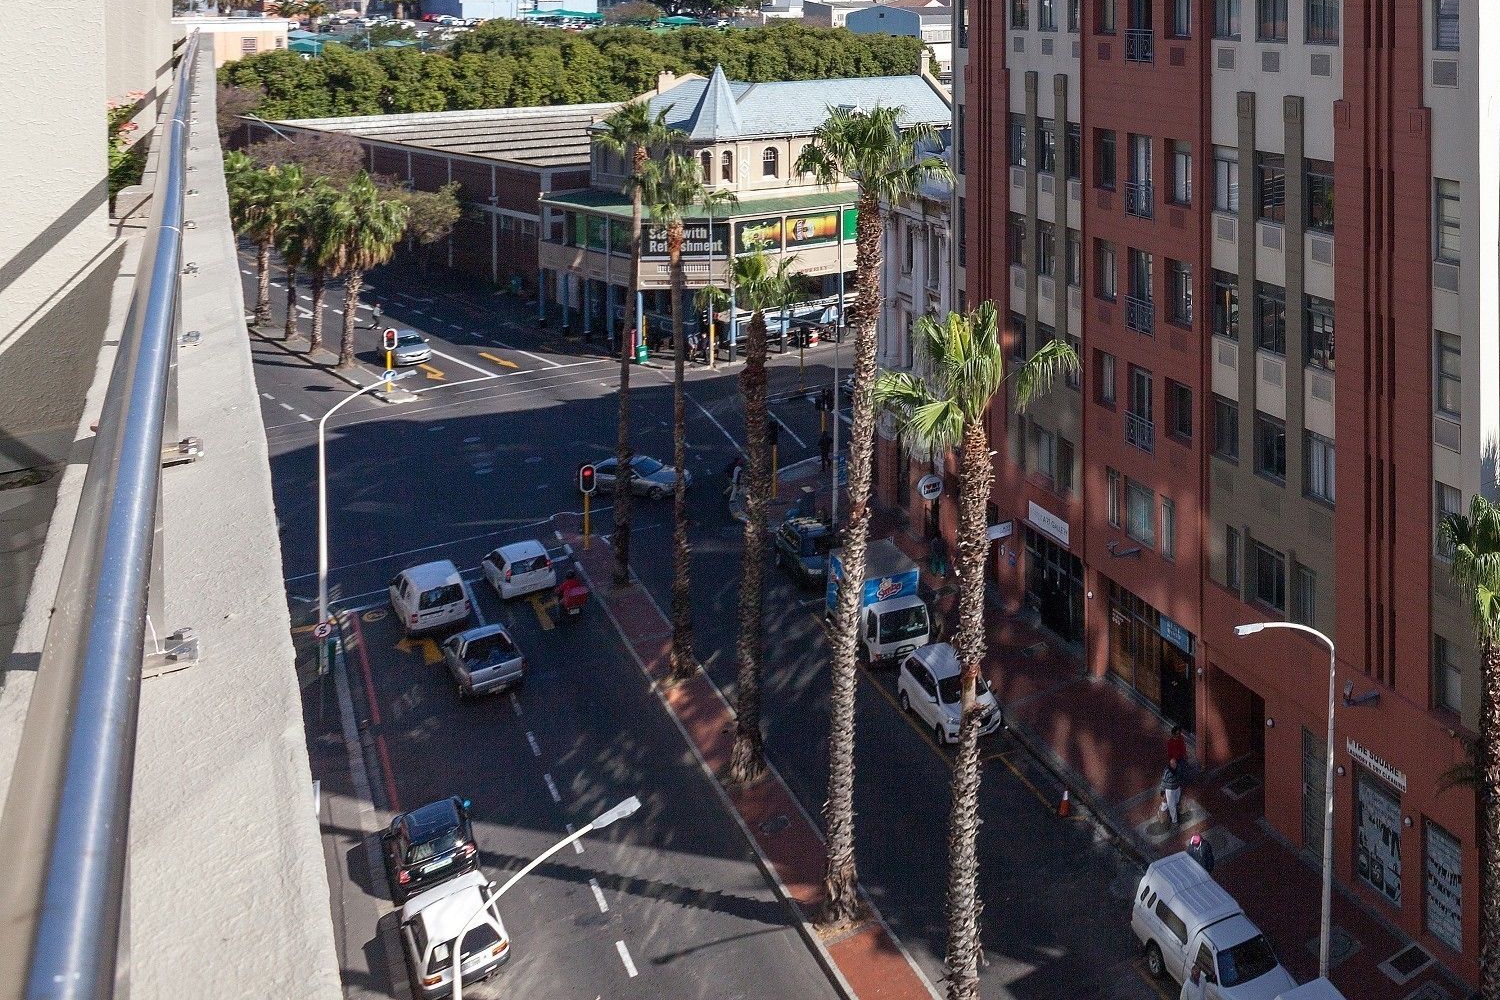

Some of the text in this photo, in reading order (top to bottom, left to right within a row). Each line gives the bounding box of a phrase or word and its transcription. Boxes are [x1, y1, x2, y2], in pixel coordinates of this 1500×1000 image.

[683, 227, 708, 239] with
[649, 239, 723, 253] Refshment
[1369, 752, 1399, 777] SQUARE
